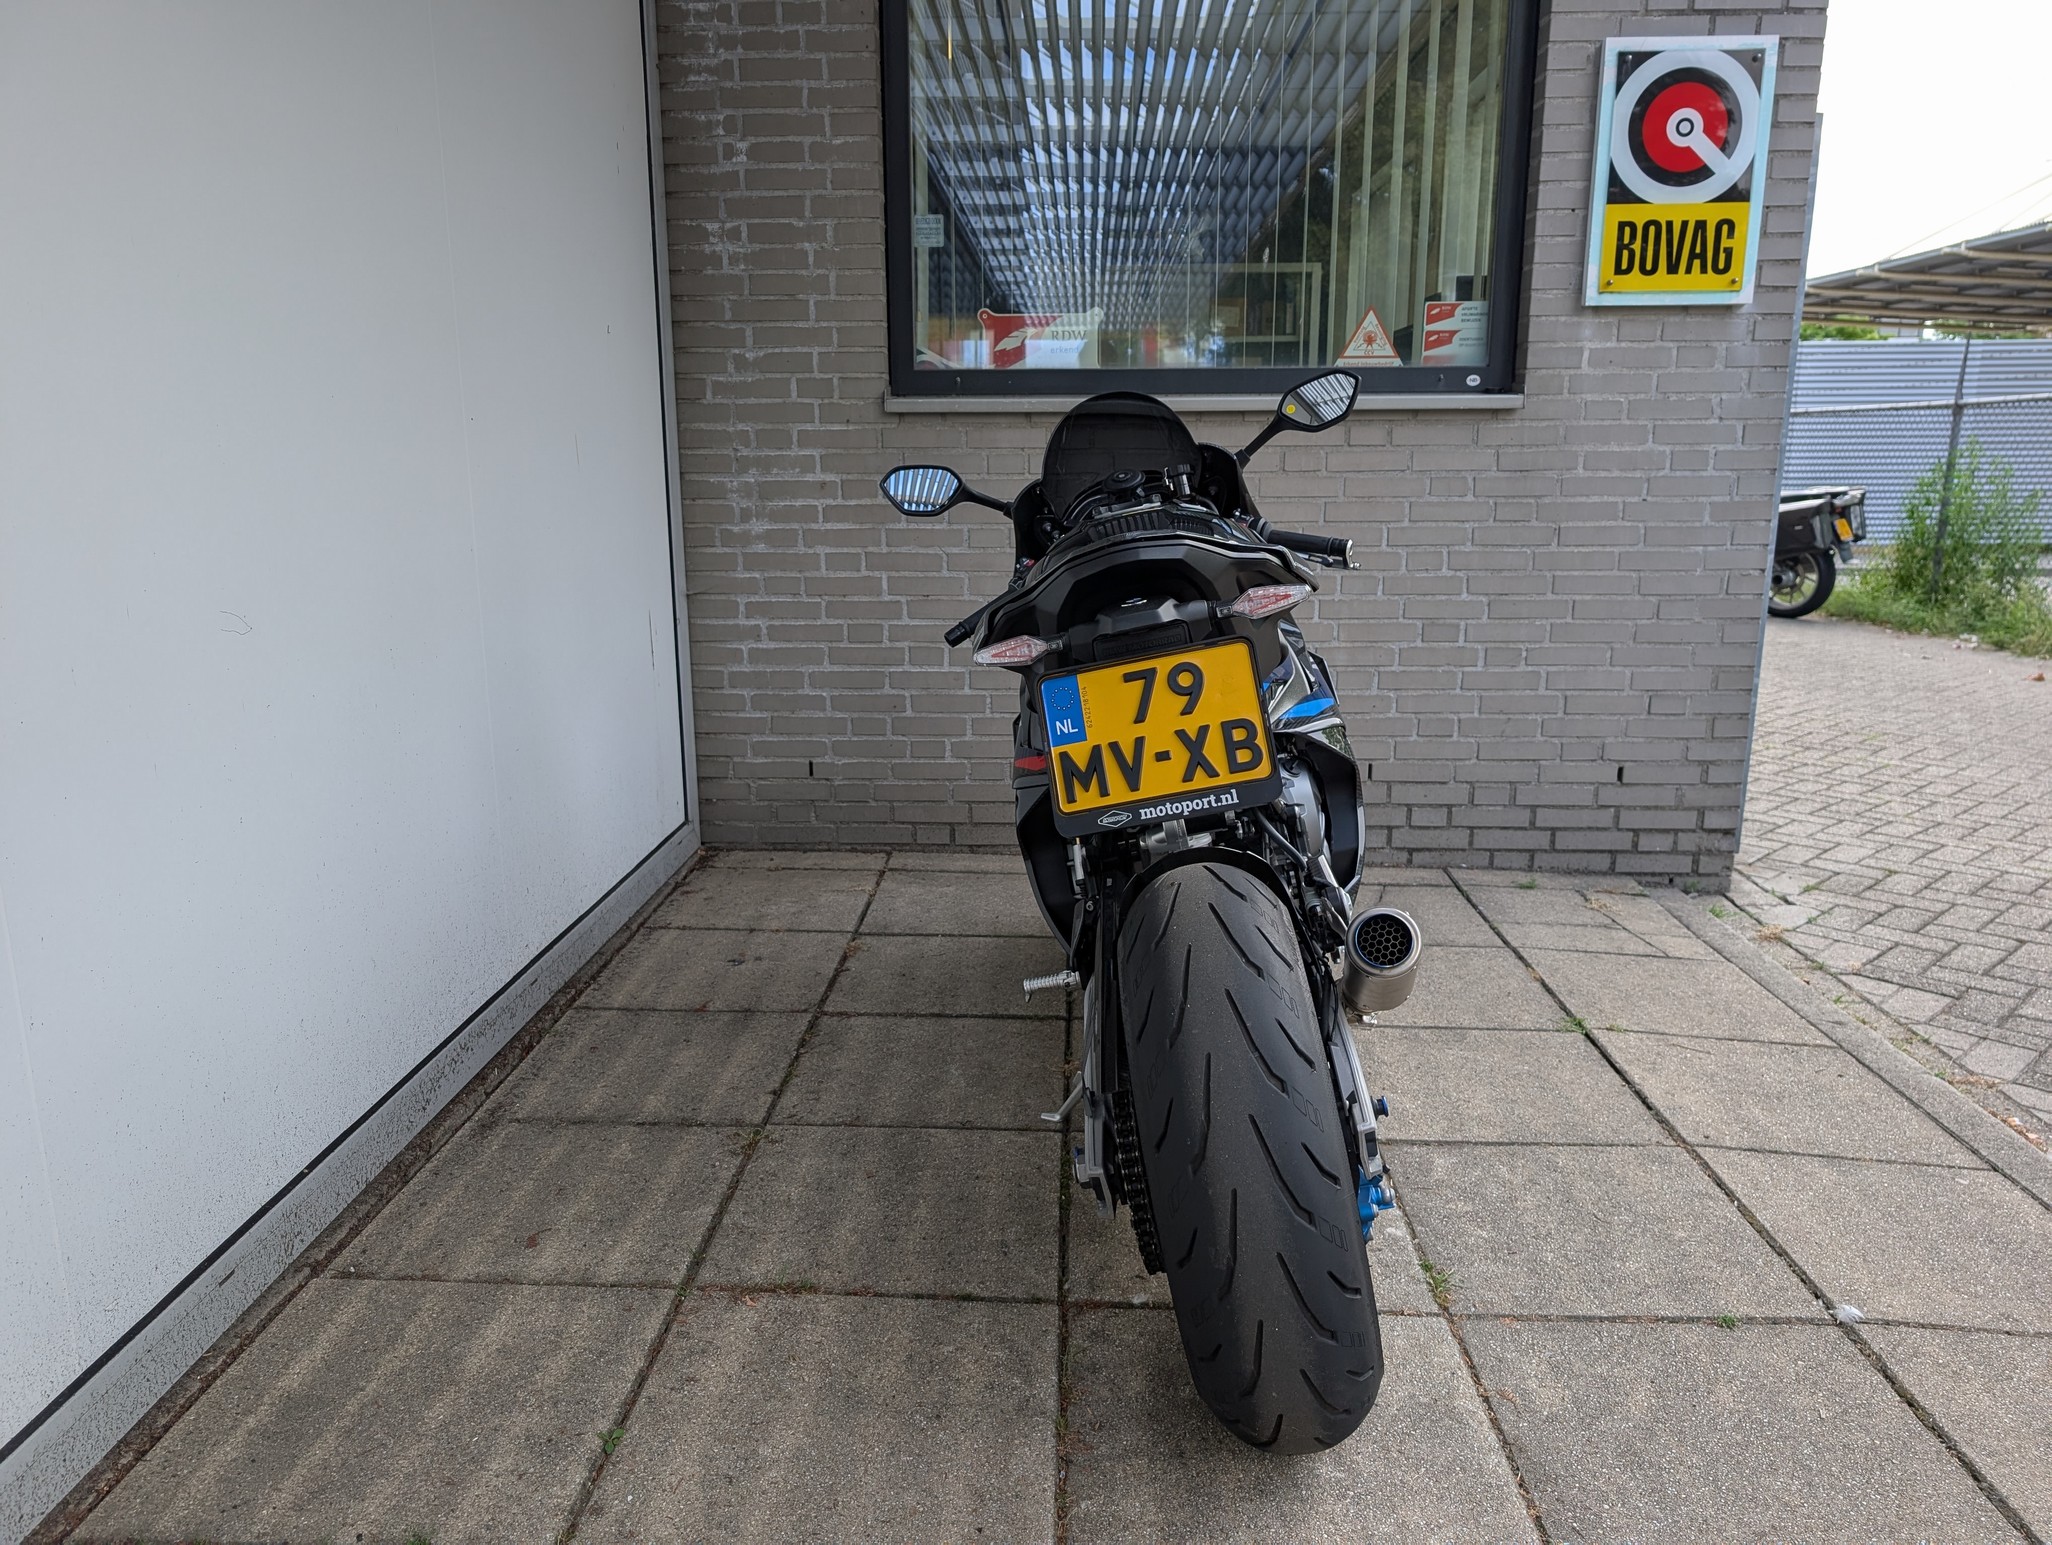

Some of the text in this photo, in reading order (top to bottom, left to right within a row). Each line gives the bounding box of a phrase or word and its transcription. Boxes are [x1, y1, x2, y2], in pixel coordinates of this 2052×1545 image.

[1613, 218, 1736, 277] BOVAG
[1050, 346, 1080, 354] erkend
[1051, 330, 1088, 341] RDW
[1122, 661, 1206, 725] 79
[1055, 718, 1079, 736] NL
[1058, 718, 1264, 804] MV-XB
[1139, 789, 1240, 820] motoport.nl
